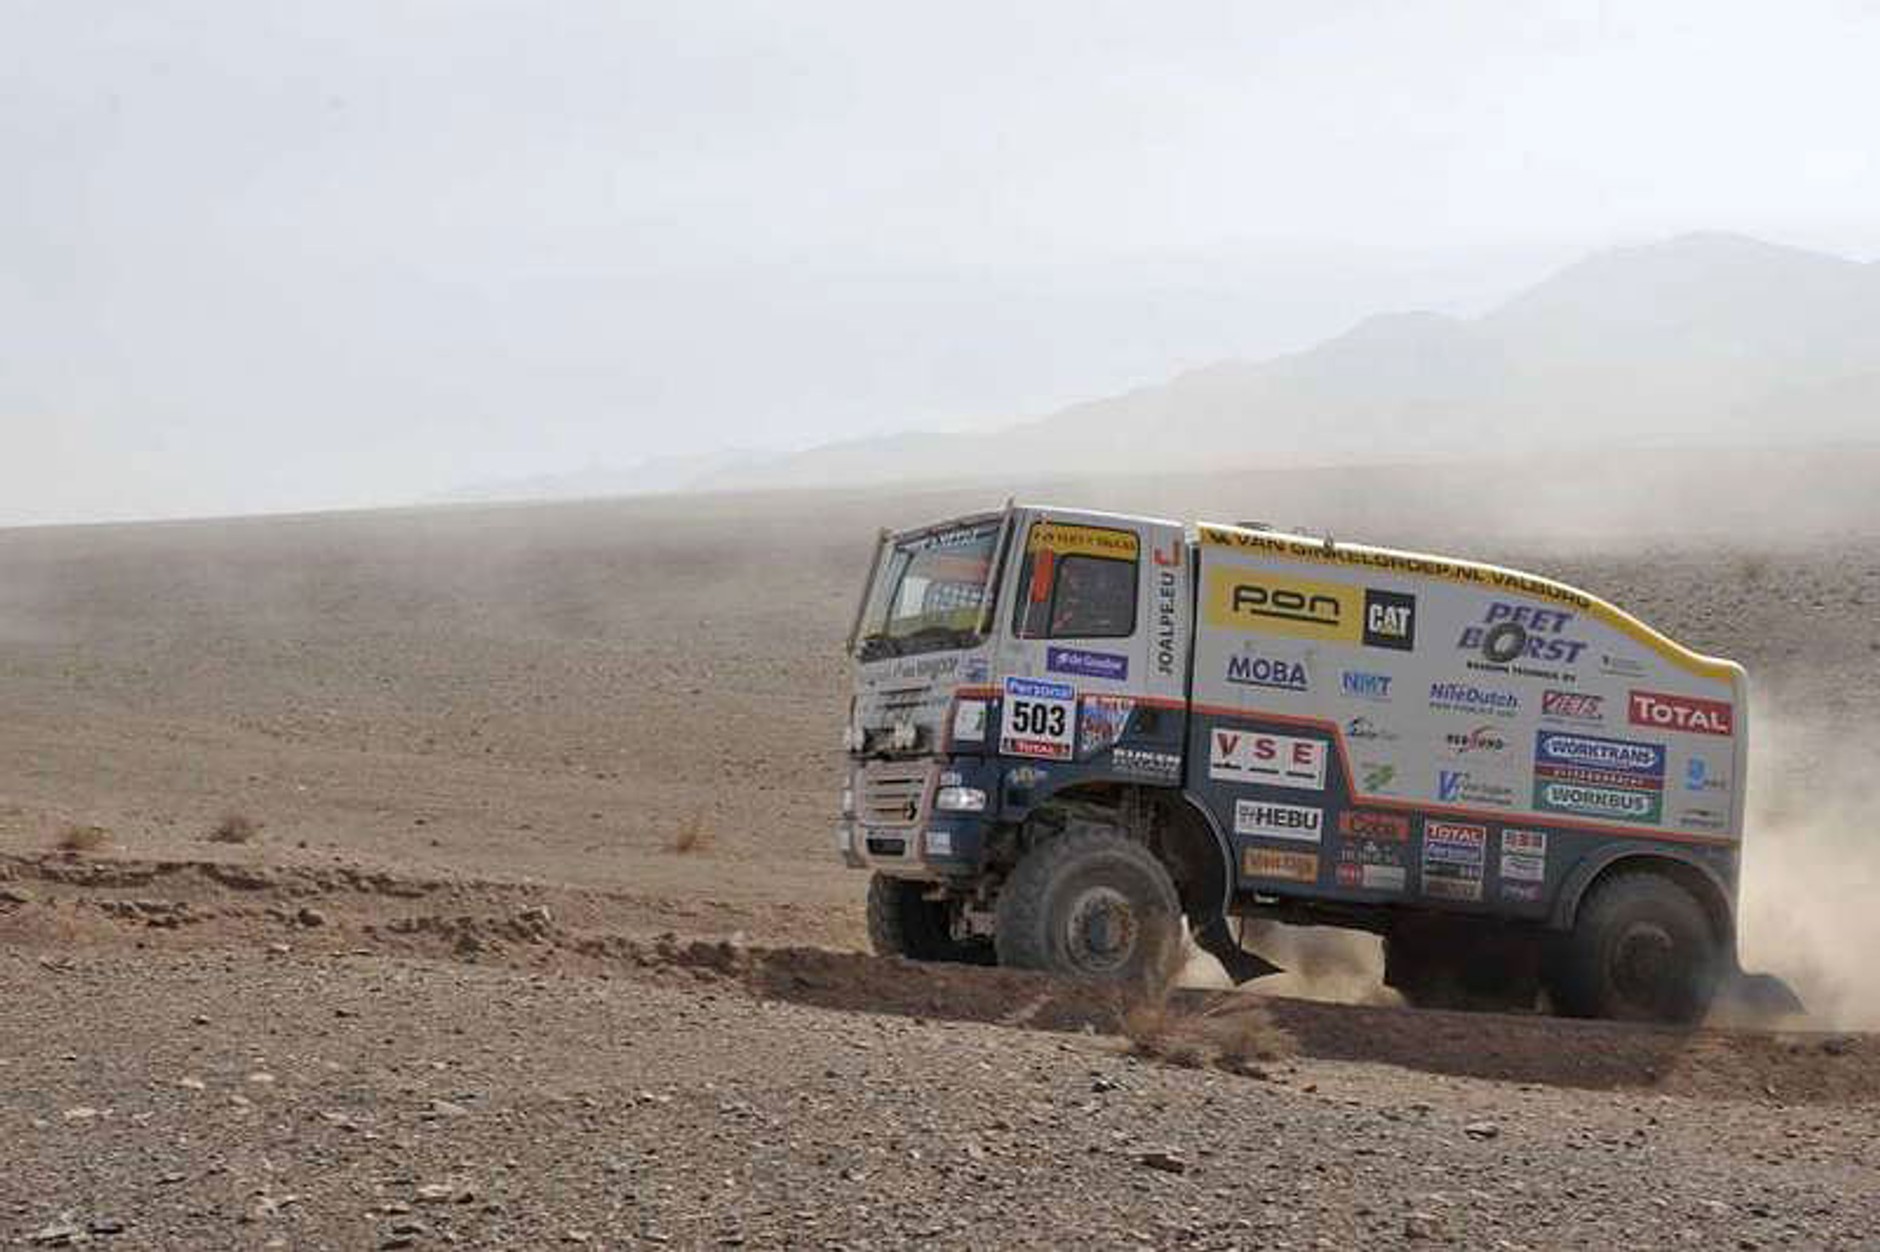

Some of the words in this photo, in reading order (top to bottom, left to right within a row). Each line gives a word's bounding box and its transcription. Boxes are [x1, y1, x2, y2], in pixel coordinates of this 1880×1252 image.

[1368, 603, 1412, 637] CAT
[1484, 602, 1575, 634] PEET
[1226, 656, 1308, 686] MOBA
[1012, 701, 1066, 737] 503
[1632, 696, 1730, 733] TOTAL
[1256, 806, 1319, 831] HEBU
